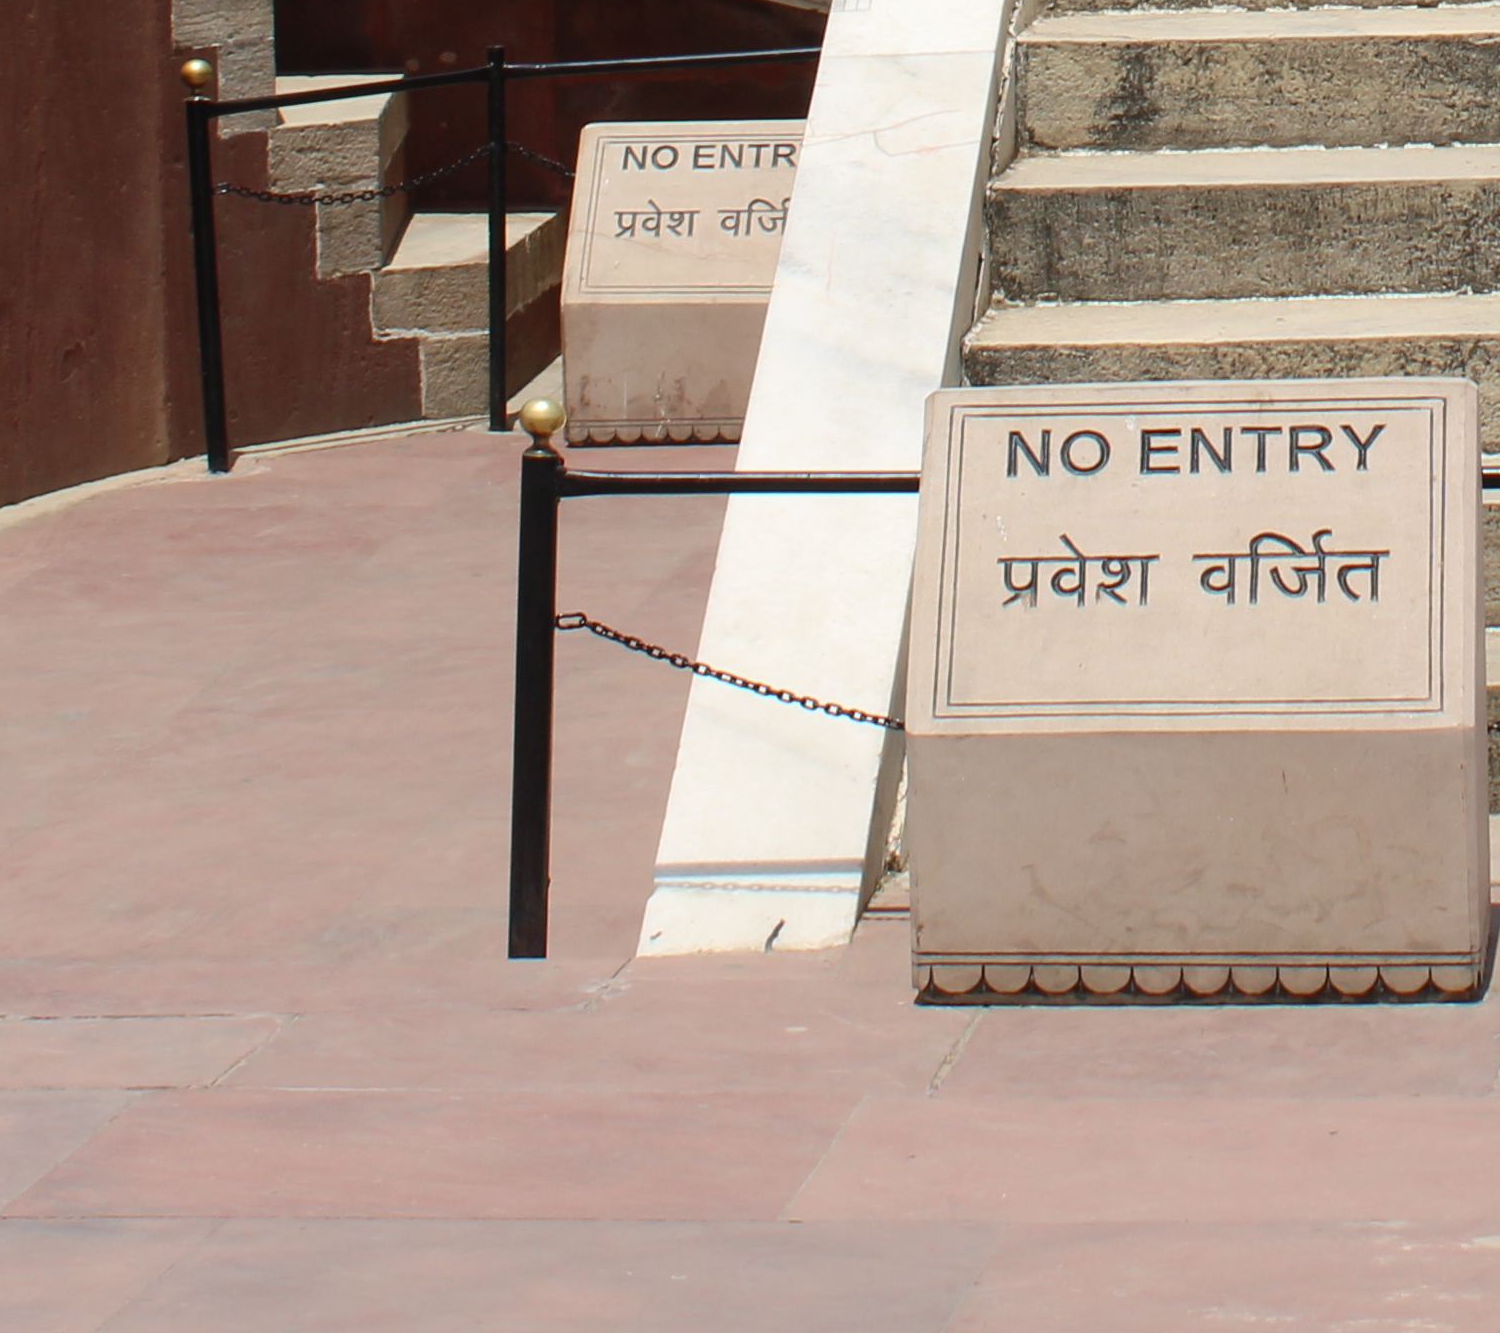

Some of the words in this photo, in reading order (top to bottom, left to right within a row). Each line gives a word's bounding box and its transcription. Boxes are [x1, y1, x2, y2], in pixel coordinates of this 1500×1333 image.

[621, 144, 680, 171] NO
[691, 142, 802, 170] ENTR
[613, 199, 701, 238] प्रवेश
[717, 197, 791, 237] वर्जि
[1005, 429, 1111, 478] NO
[1138, 423, 1388, 475] ENTRY
[996, 533, 1161, 608] प्रवेश
[1191, 528, 1391, 605] वर्जित
